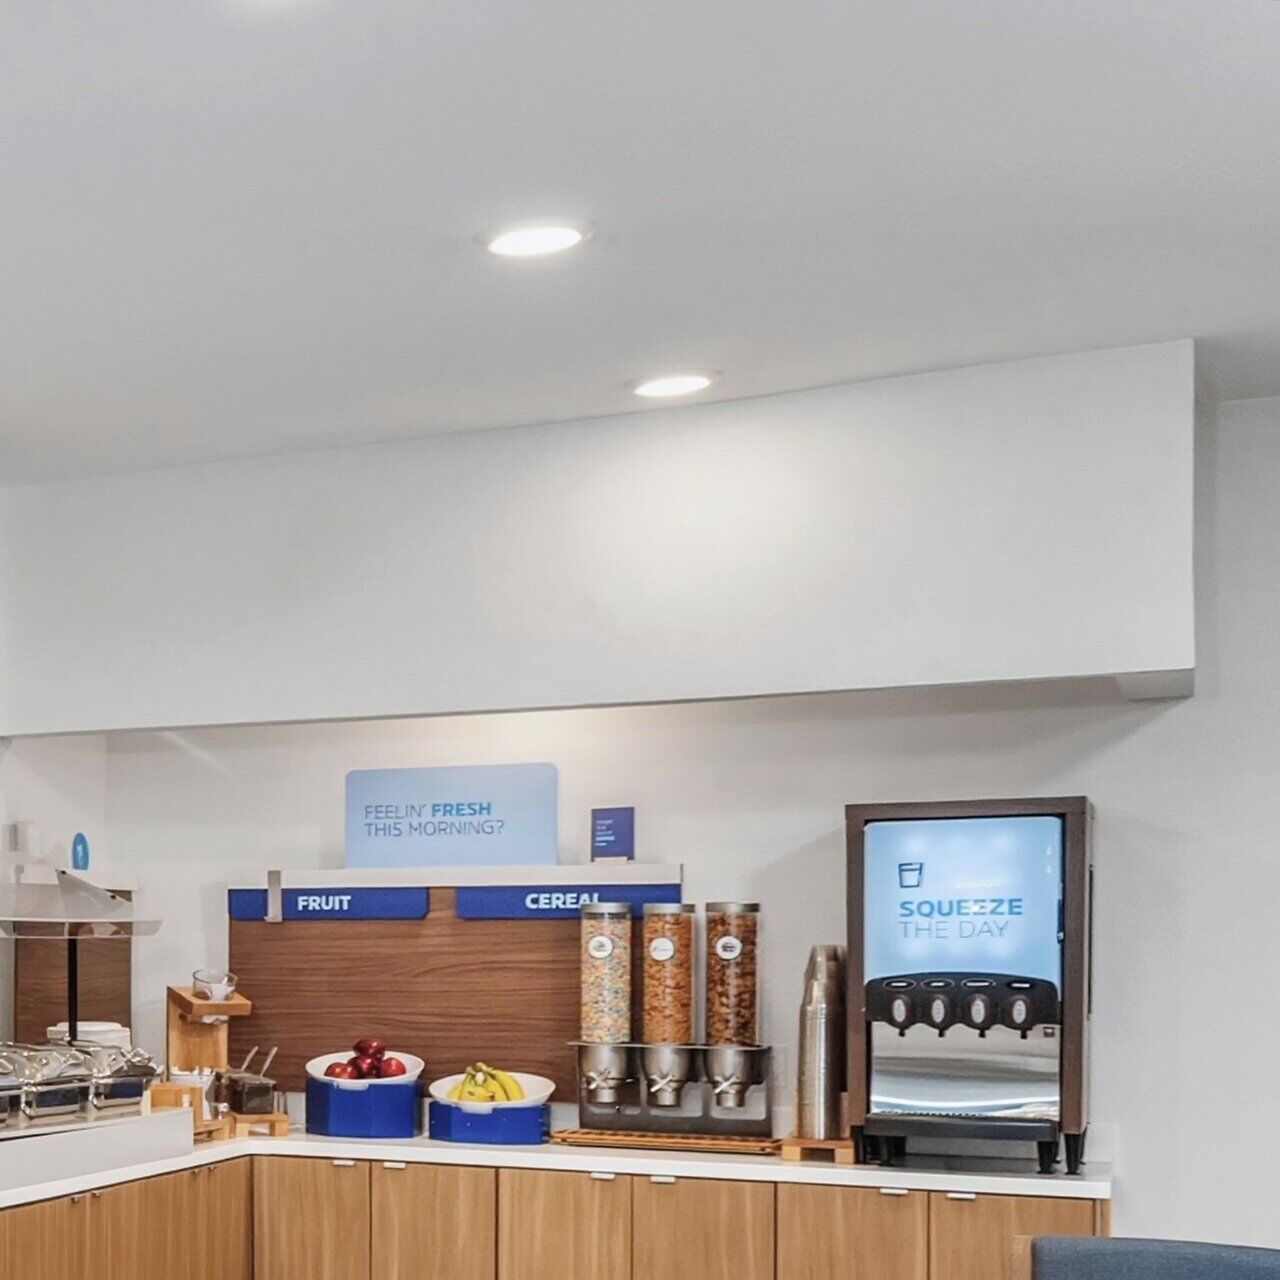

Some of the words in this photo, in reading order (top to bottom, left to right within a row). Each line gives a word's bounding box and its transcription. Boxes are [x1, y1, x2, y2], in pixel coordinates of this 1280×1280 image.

[431, 802, 492, 818] FRESH
[364, 823, 403, 838] THIS
[408, 819, 505, 837] MORNING?
[297, 894, 352, 911] FRUIT
[897, 897, 1024, 919] SQUEEZE
[897, 920, 949, 940] THE
[958, 919, 1010, 939] DAY
